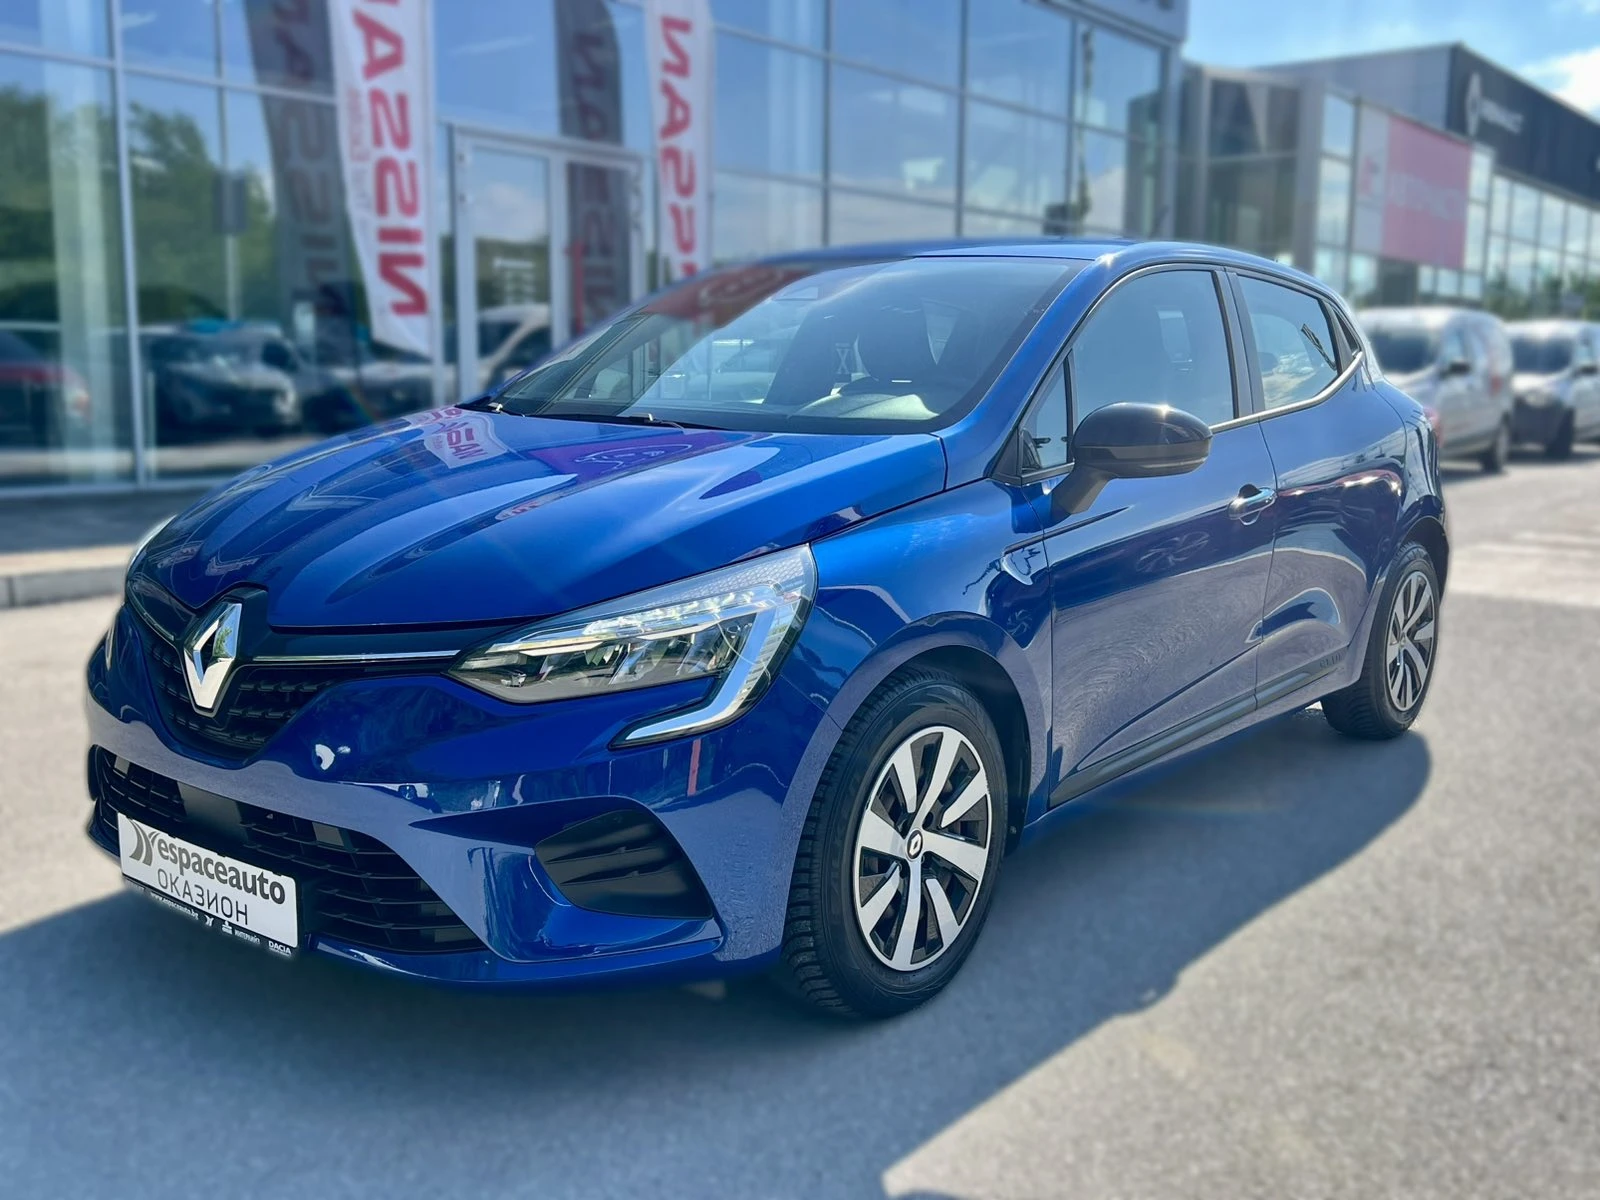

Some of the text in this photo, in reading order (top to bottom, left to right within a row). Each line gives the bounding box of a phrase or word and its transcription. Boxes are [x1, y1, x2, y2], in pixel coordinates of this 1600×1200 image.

[157, 868, 249, 926] ОКАЗИОН
[158, 836, 286, 905] espaceauto
[268, 940, 292, 955] DACIA
